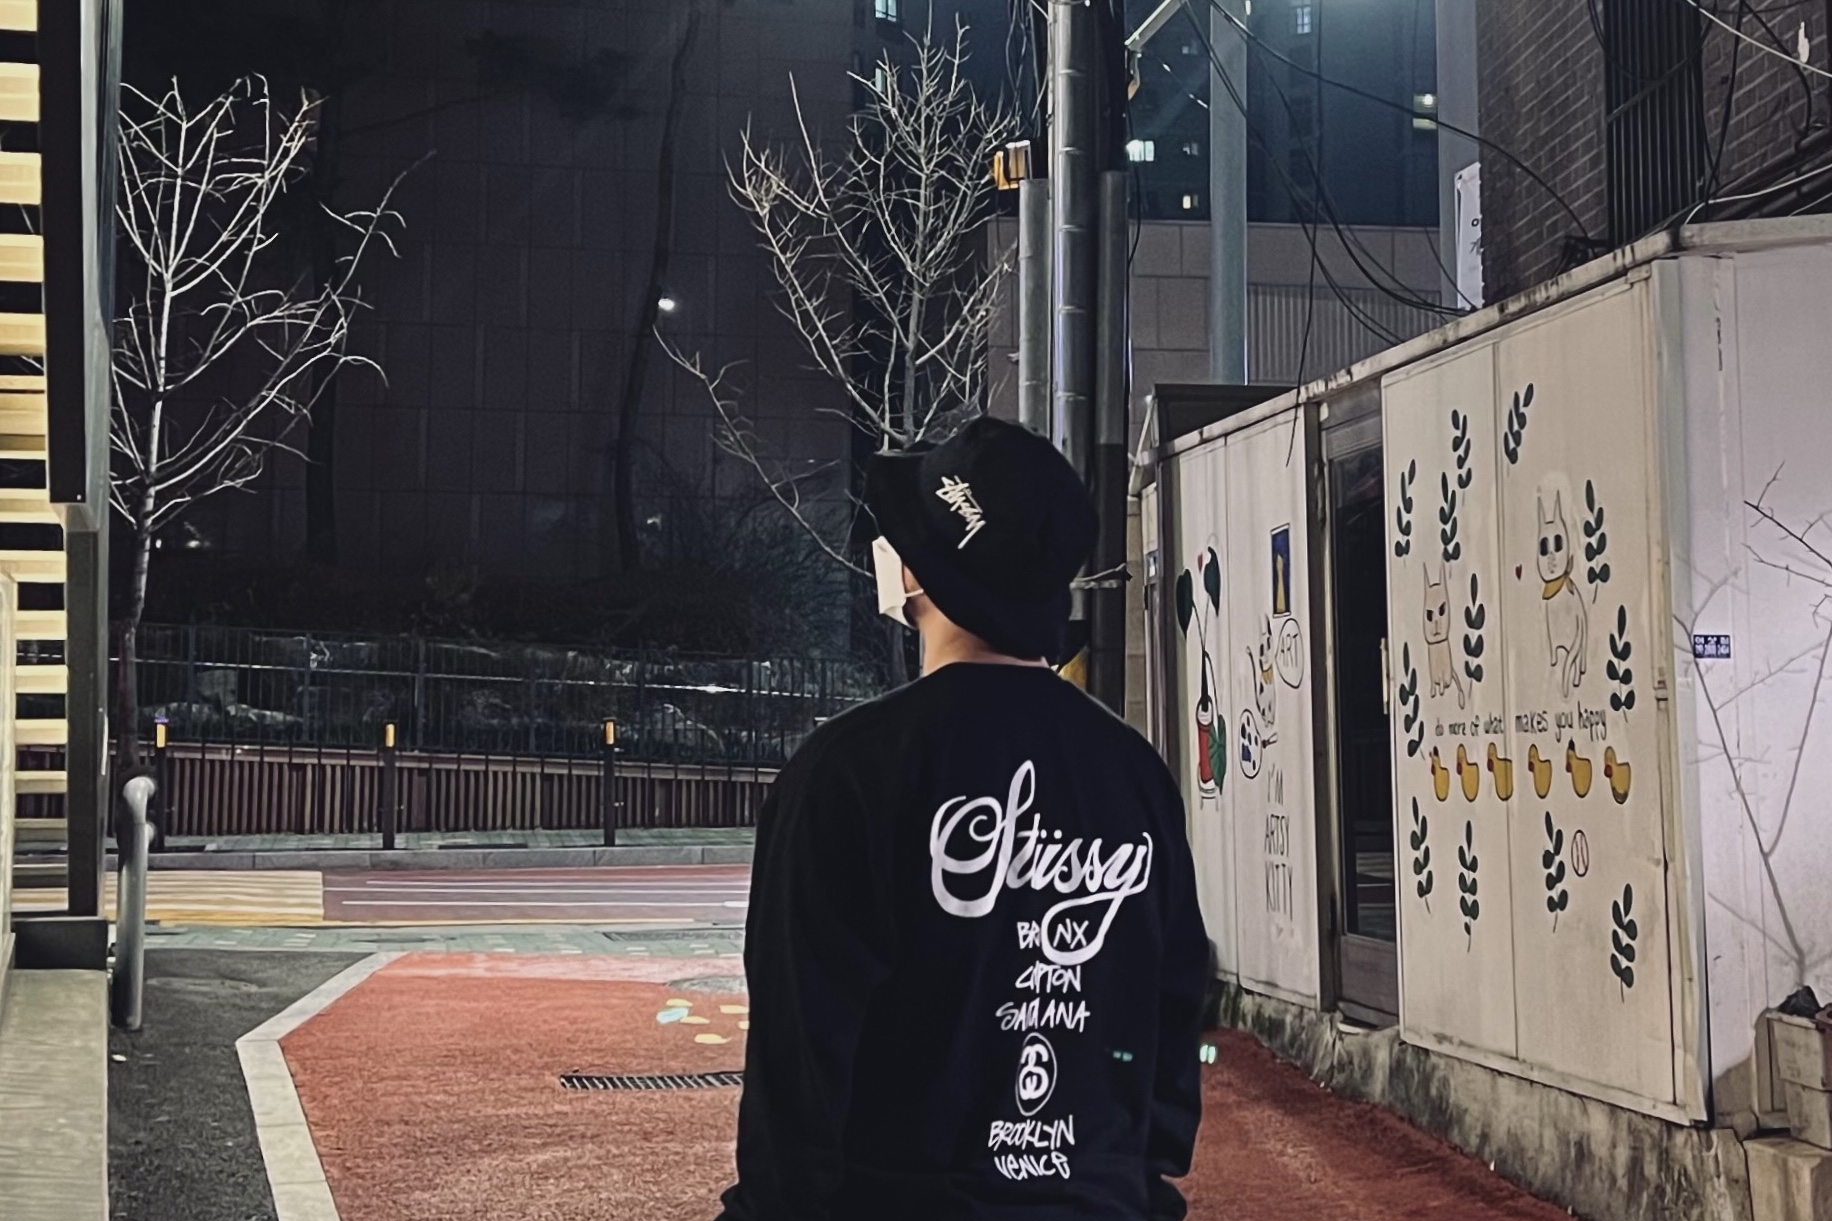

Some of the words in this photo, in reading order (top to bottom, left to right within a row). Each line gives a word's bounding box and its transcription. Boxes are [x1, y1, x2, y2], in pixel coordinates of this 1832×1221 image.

[1280, 633, 1299, 668] ART
[1515, 710, 1549, 735] makes
[1555, 710, 1574, 742] you
[1578, 700, 1607, 742] happy
